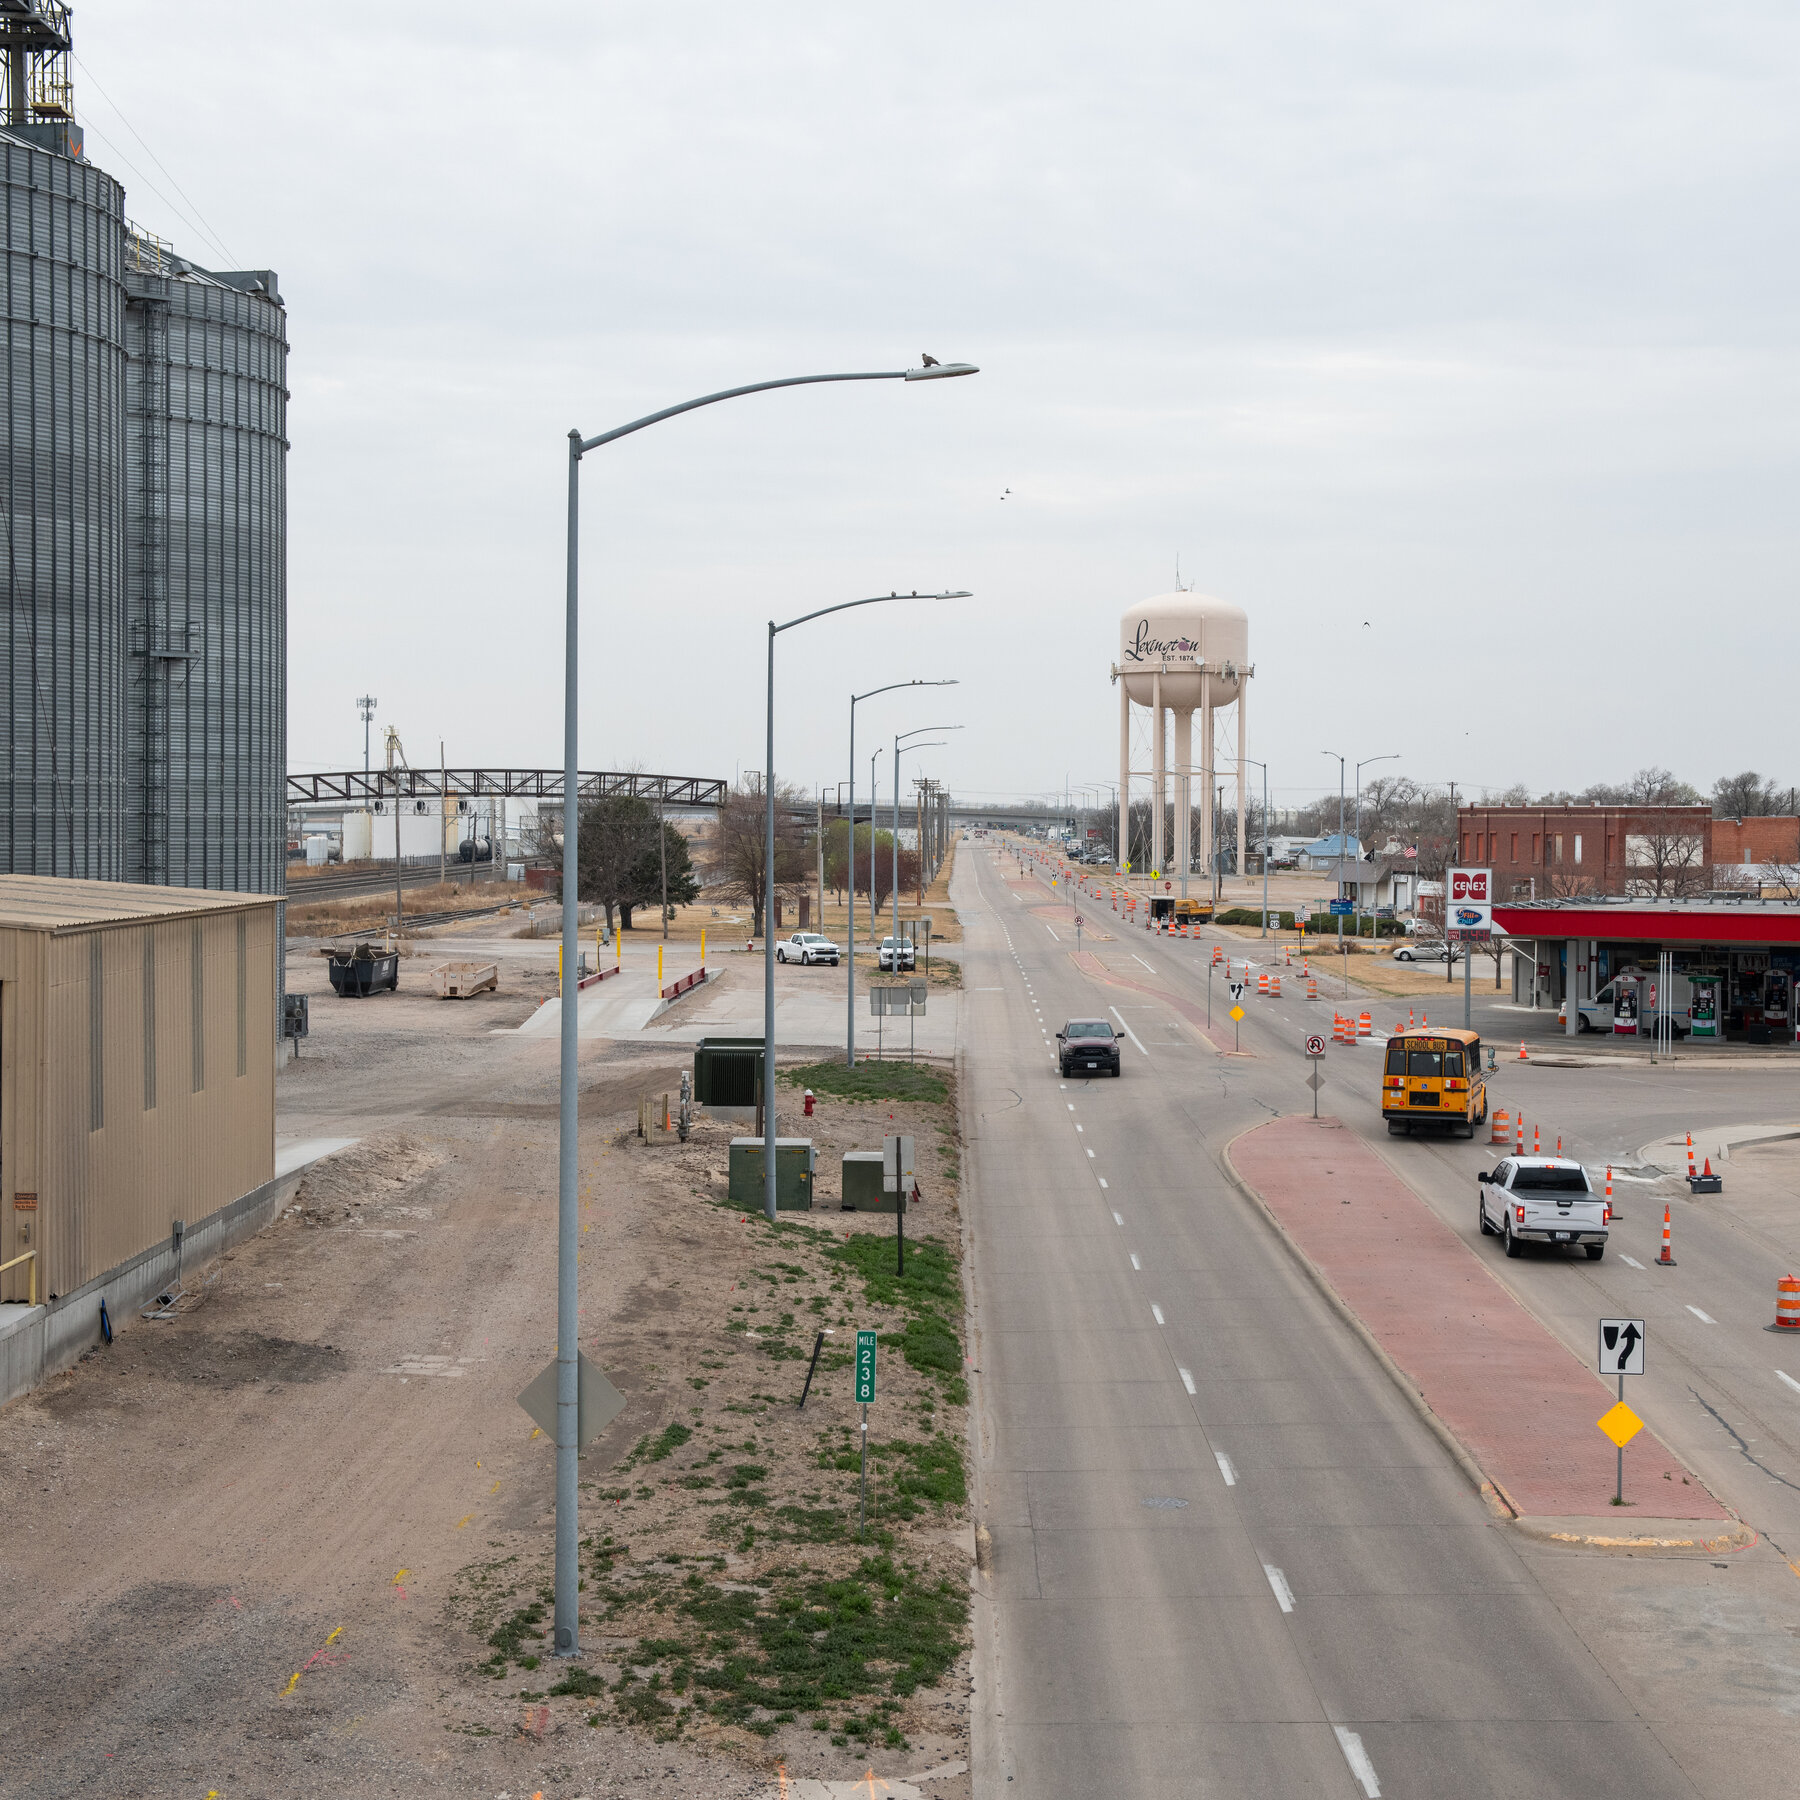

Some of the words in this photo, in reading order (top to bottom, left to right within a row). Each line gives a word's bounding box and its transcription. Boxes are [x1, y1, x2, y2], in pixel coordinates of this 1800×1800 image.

[1124, 619, 1199, 662] Lexington
[1454, 881, 1486, 891] CENEX
[1406, 1040, 1430, 1050] SCHOOL
[1433, 1040, 1445, 1050] BUS
[858, 1336, 874, 1346] MILE
